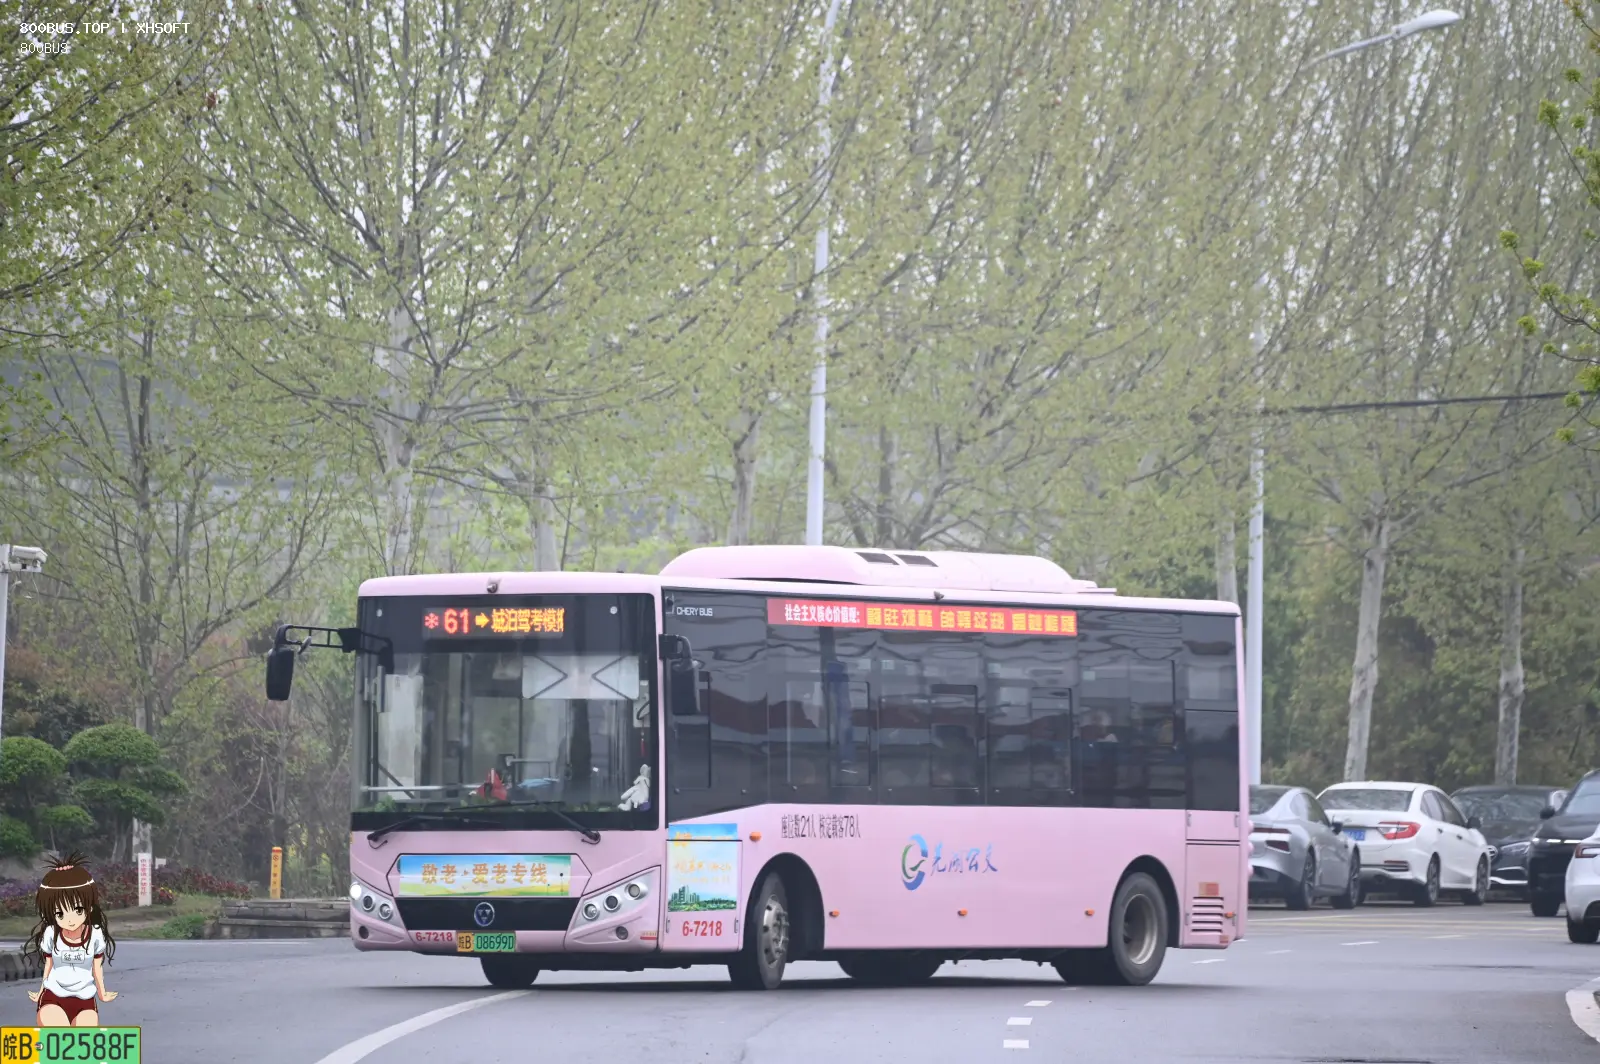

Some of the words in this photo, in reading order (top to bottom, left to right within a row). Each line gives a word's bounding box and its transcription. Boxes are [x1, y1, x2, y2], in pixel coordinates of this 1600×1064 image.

[676, 606, 699, 616] CHERY
[699, 607, 714, 617] BUS
[443, 607, 470, 634] 61
[682, 920, 723, 937] 6-7218
[415, 931, 453, 942] 6-7218
